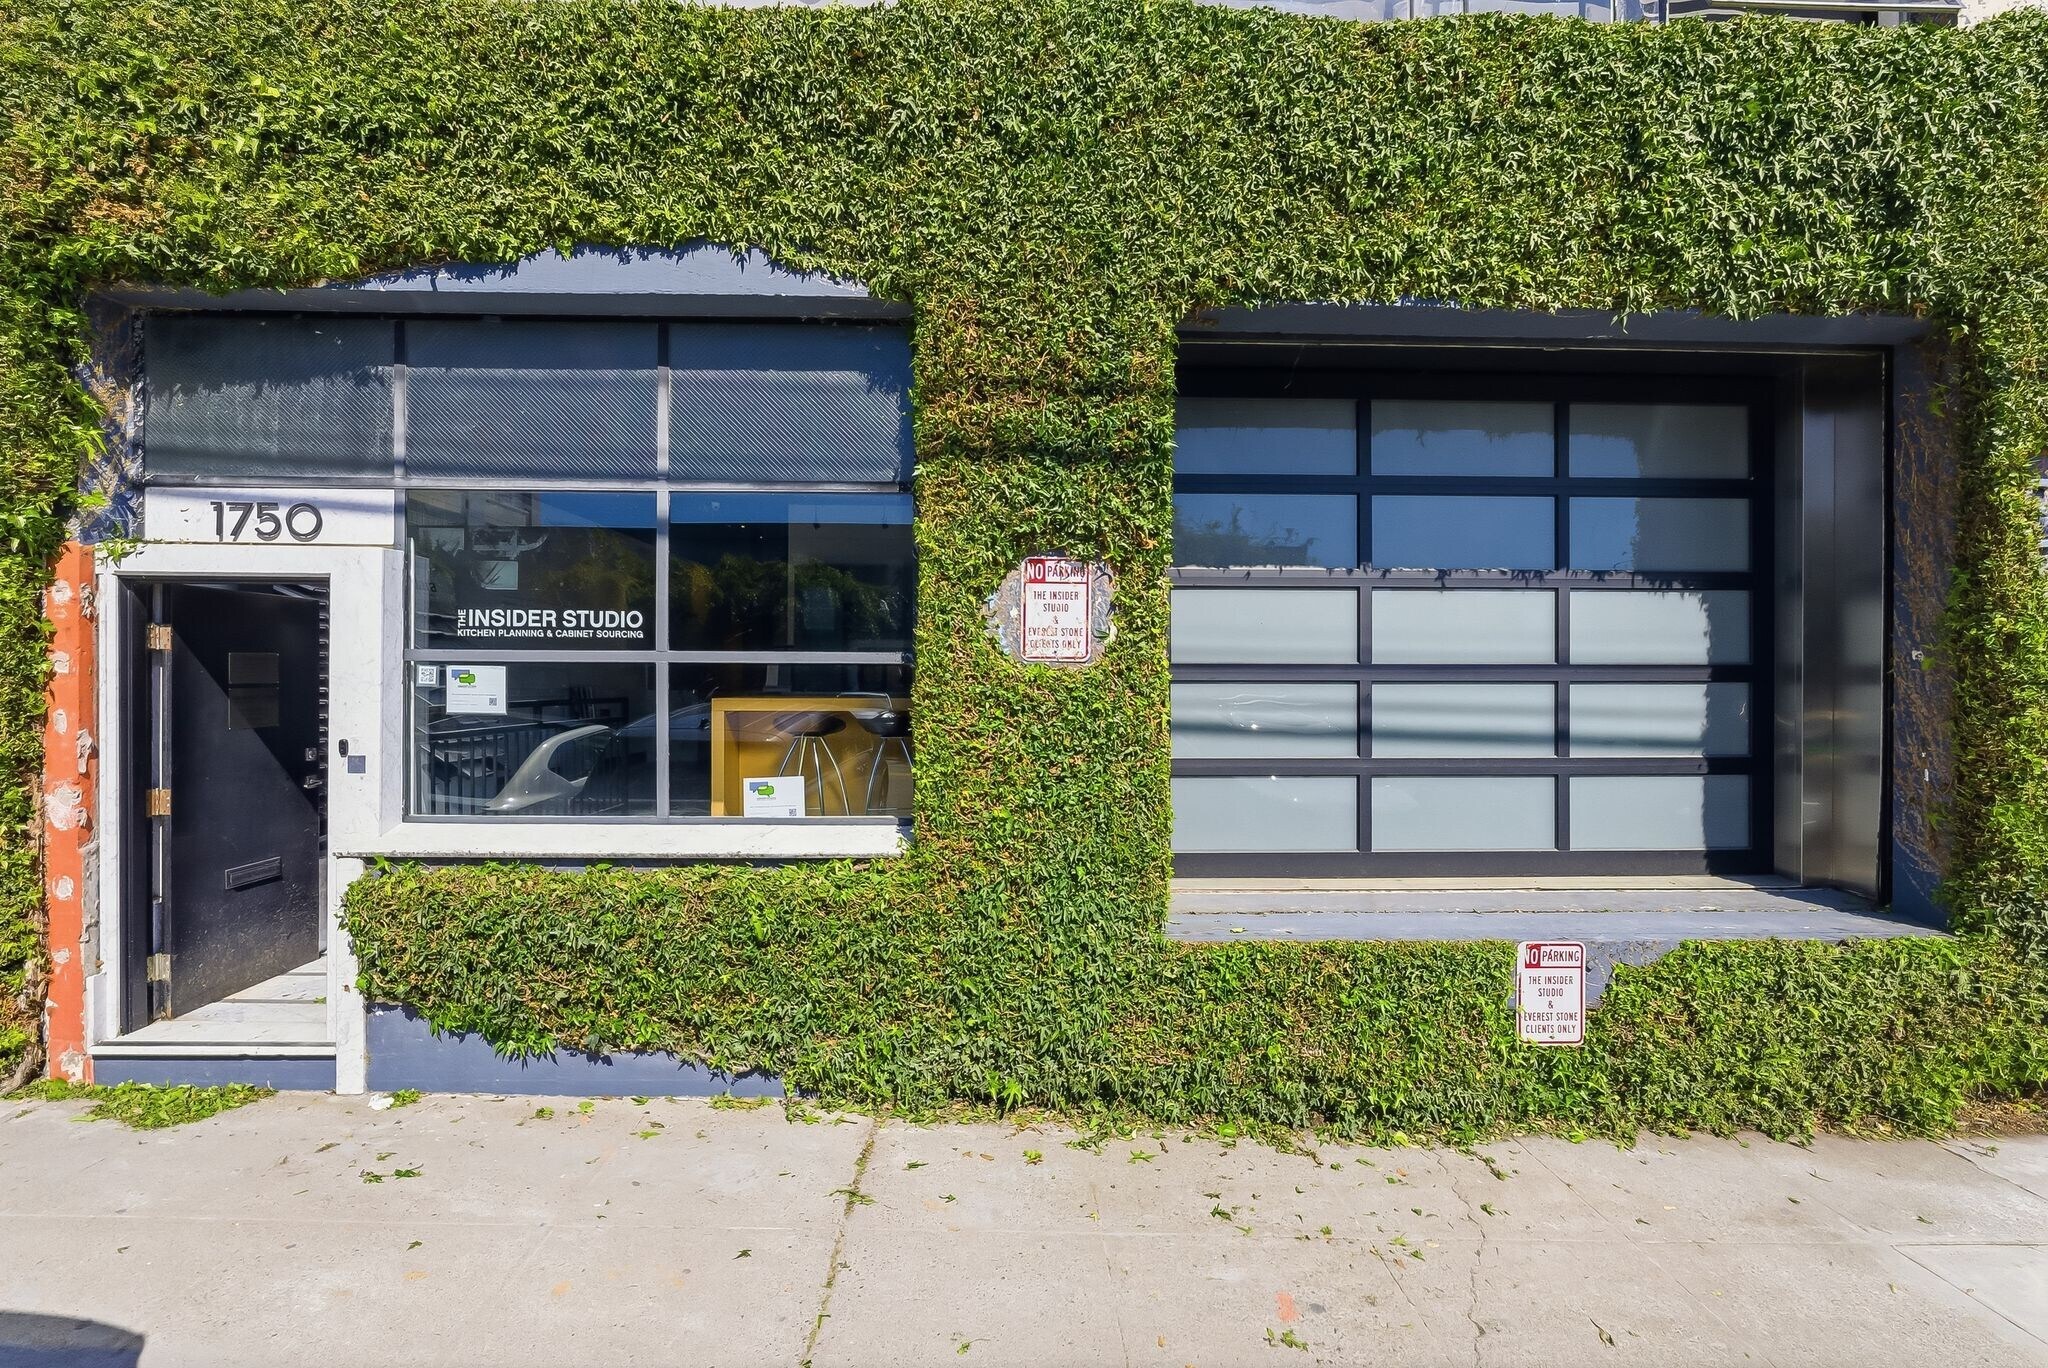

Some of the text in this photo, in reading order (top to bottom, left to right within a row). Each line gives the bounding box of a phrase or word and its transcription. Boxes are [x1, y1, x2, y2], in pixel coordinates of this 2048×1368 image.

[210, 501, 323, 543] 1750
[1027, 563, 1044, 580] NO
[1033, 590, 1079, 600] THE INSIDER
[1043, 603, 1069, 613] STUDIO
[457, 609, 644, 628] THE INSIDER STUDIO
[457, 629, 644, 638] KITCHEN PLANNING & CABINET SOURCING
[1060, 627, 1083, 637] STONE
[1542, 949, 1580, 962] PARKING
[1528, 975, 1574, 985] THE INSIDER
[1537, 987, 1564, 997] STUDIO
[1547, 1000, 1554, 1009] &
[1523, 1011, 1579, 1021] EVEREST STONE
[1525, 1024, 1576, 1034] CLIENTS ONLY
